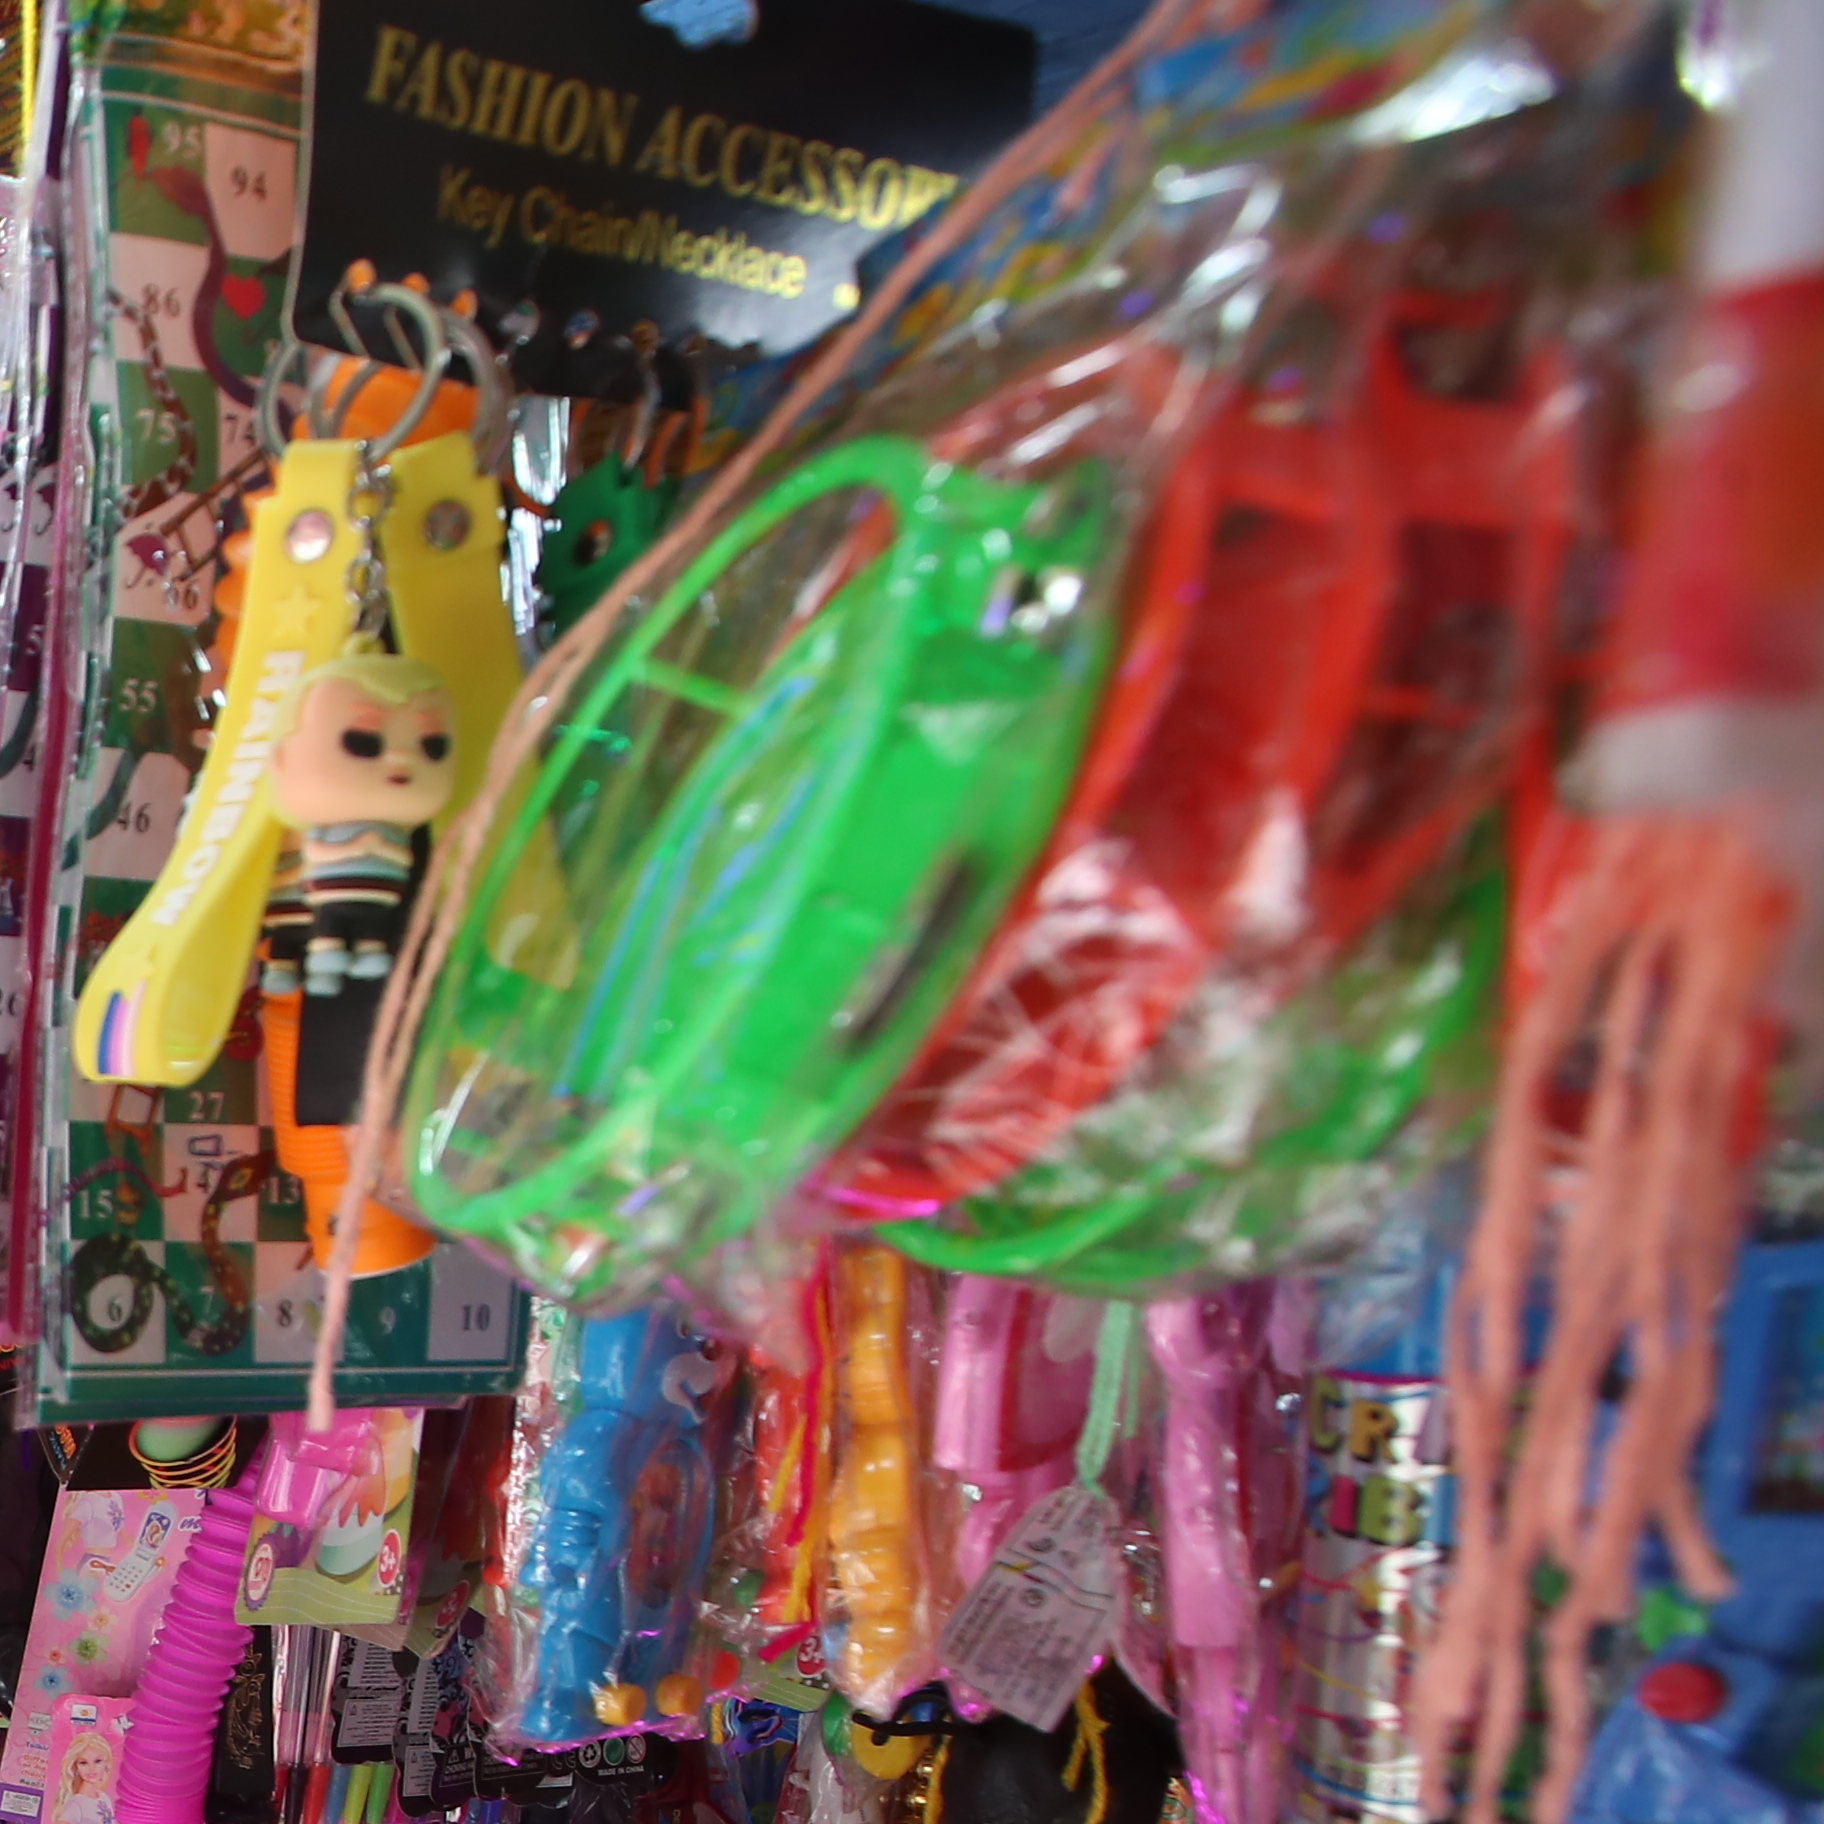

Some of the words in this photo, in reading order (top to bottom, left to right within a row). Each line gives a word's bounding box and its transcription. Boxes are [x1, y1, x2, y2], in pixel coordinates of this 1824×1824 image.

[161, 120, 203, 159] 95
[365, 24, 640, 167] FASHION
[635, 104, 961, 232] ACCESSOR
[230, 166, 269, 202] 94
[437, 164, 513, 250] Key
[143, 283, 182, 318] 86
[136, 408, 178, 444] 75
[119, 676, 159, 713] 55
[116, 800, 153, 835] 46
[189, 1091, 225, 1123] 27
[79, 1189, 113, 1220] 15
[278, 1300, 293, 1328] 8
[461, 1303, 491, 1332] 10
[379, 1543, 397, 1575] 3+
[597, 1767, 618, 1777] MADE
[626, 1764, 646, 1775] CHINA
